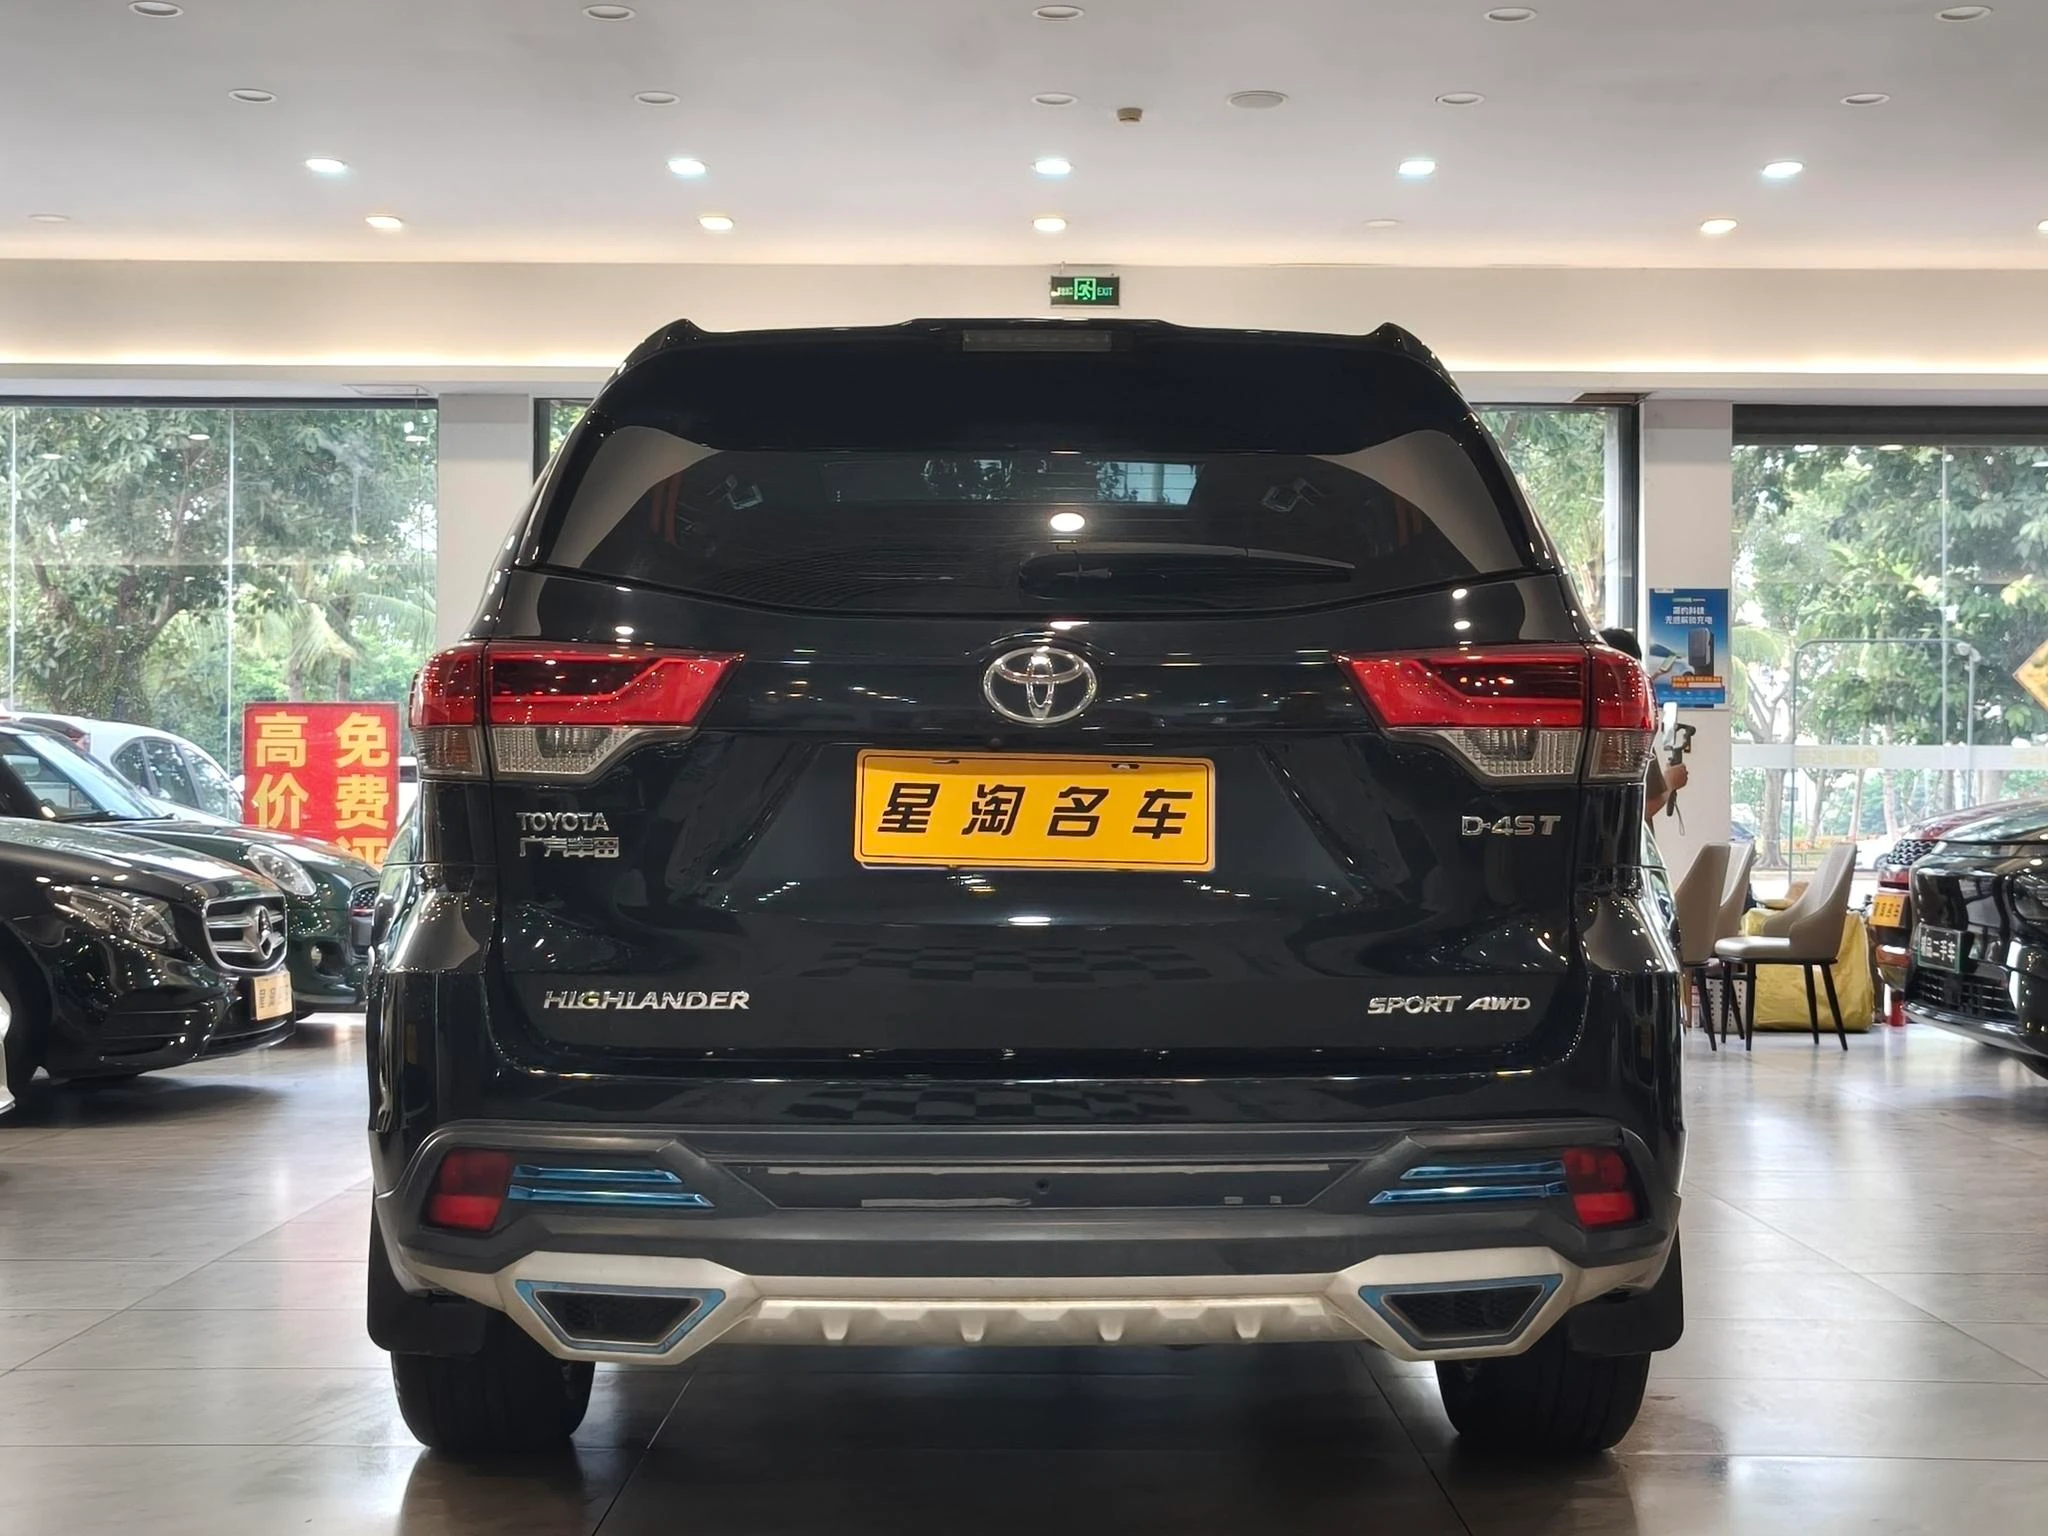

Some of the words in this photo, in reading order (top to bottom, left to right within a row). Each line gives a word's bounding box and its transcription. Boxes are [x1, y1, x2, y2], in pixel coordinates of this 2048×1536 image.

[252, 711, 309, 829] 高价
[877, 782, 1194, 839] 星淘名车
[516, 812, 610, 831] TOYOTA
[1461, 815, 1562, 836] D-4ST
[543, 990, 750, 1010] HIGHLANDER
[1367, 995, 1463, 1014] SPORT
[1465, 996, 1531, 1011] AWD
